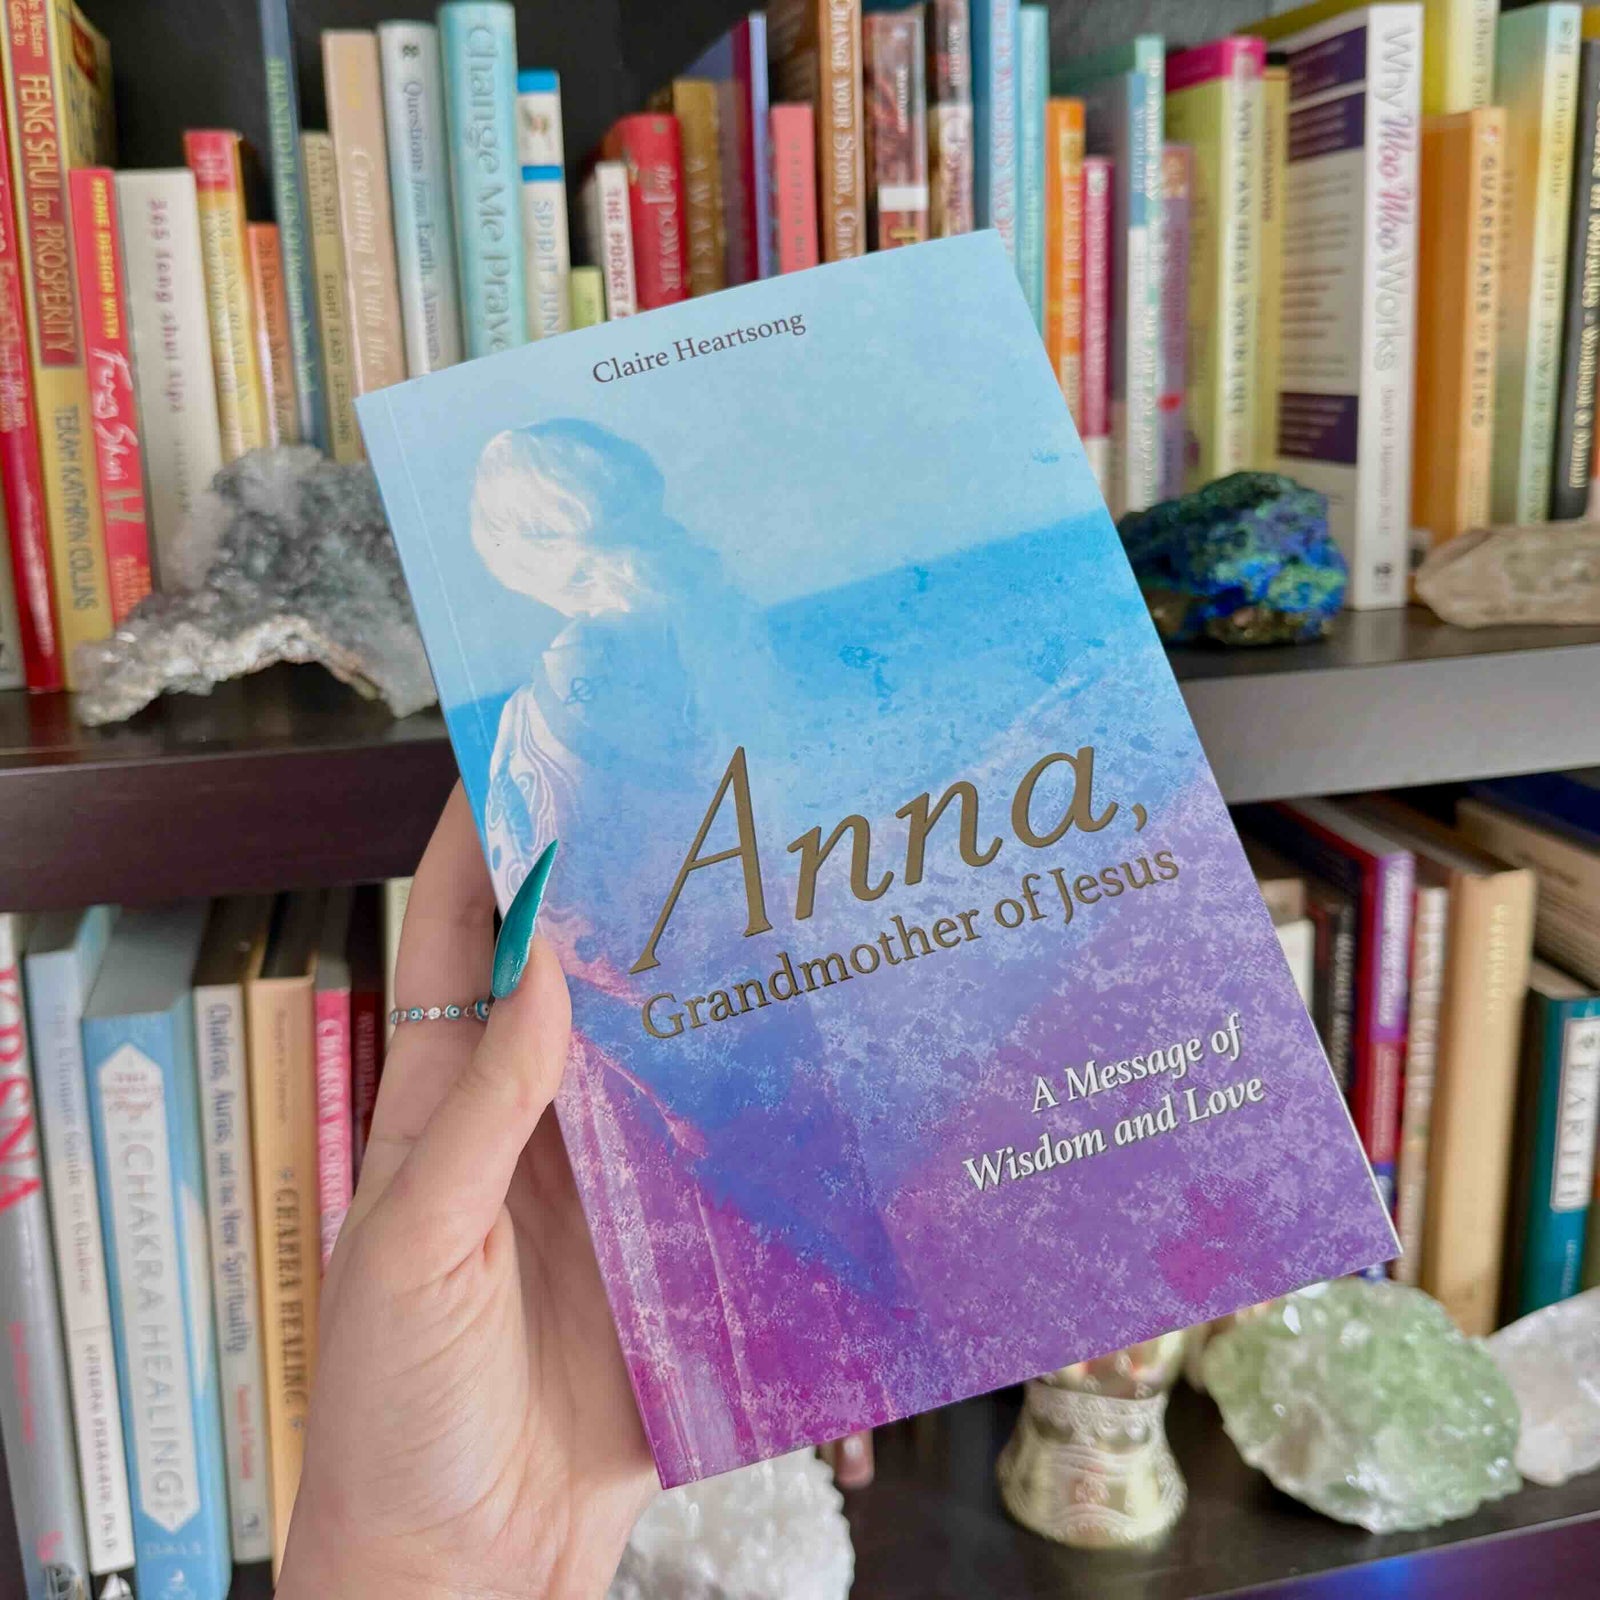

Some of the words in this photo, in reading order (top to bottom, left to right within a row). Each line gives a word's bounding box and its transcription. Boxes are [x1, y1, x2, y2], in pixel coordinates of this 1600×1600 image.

[466, 24, 499, 174] Change
[1375, 23, 1417, 109] Why
[19, 74, 55, 134] FENG
[266, 57, 293, 152] HAUNTED
[402, 80, 425, 175] Questions
[831, 78, 855, 130] YOUR
[26, 136, 59, 190] SHUI
[1378, 114, 1415, 183] Woo
[32, 196, 60, 219] for
[91, 177, 108, 219] HOME
[274, 156, 298, 222] PLACES
[350, 149, 378, 253] Creating
[480, 186, 507, 241] Me
[605, 187, 625, 222] THE
[1376, 186, 1412, 250] Woo
[94, 223, 116, 291] DESIGN
[533, 200, 559, 274] SPIRIT
[609, 230, 632, 305] POCKET
[642, 192, 682, 292] POWER
[1474, 155, 1499, 311] GUARDIANS
[36, 224, 75, 352] PROSPERITY
[153, 251, 177, 304] feng
[1374, 253, 1409, 371] Works
[102, 298, 120, 340] WITH
[160, 313, 181, 362] shui
[592, 343, 671, 384] Claire
[672, 313, 807, 362] Heartsong
[88, 347, 134, 419] Feng
[1576, 326, 1599, 408] Workbook
[54, 405, 81, 459] TERAH
[95, 423, 139, 482] Shui
[1569, 429, 1592, 489] Manual
[60, 463, 91, 537] KATHRYN
[67, 539, 98, 611] COLLINS
[628, 745, 1150, 975] Anna,
[641, 909, 982, 1040] Grandmother
[993, 873, 1046, 930] of
[1047, 850, 1180, 925] Jesus
[208, 1003, 235, 1081] Chakras,
[319, 1019, 346, 1119] CHAKRA
[1030, 1077, 1060, 1114] A
[1064, 1038, 1204, 1104] Message
[1210, 1013, 1243, 1062] of
[210, 1088, 238, 1145] Auras,
[963, 1126, 1108, 1192] Wisdom
[1113, 1098, 1179, 1149] and
[1186, 1073, 1266, 1124] Love
[217, 1150, 236, 1177] and
[117, 1143, 167, 1307] CHAKRA
[219, 1208, 244, 1246] New
[275, 1187, 303, 1289] CHAKRA
[219, 1251, 252, 1354] Spirituality
[280, 1301, 310, 1407] HEALING
[140, 1324, 186, 1494] HEALING
